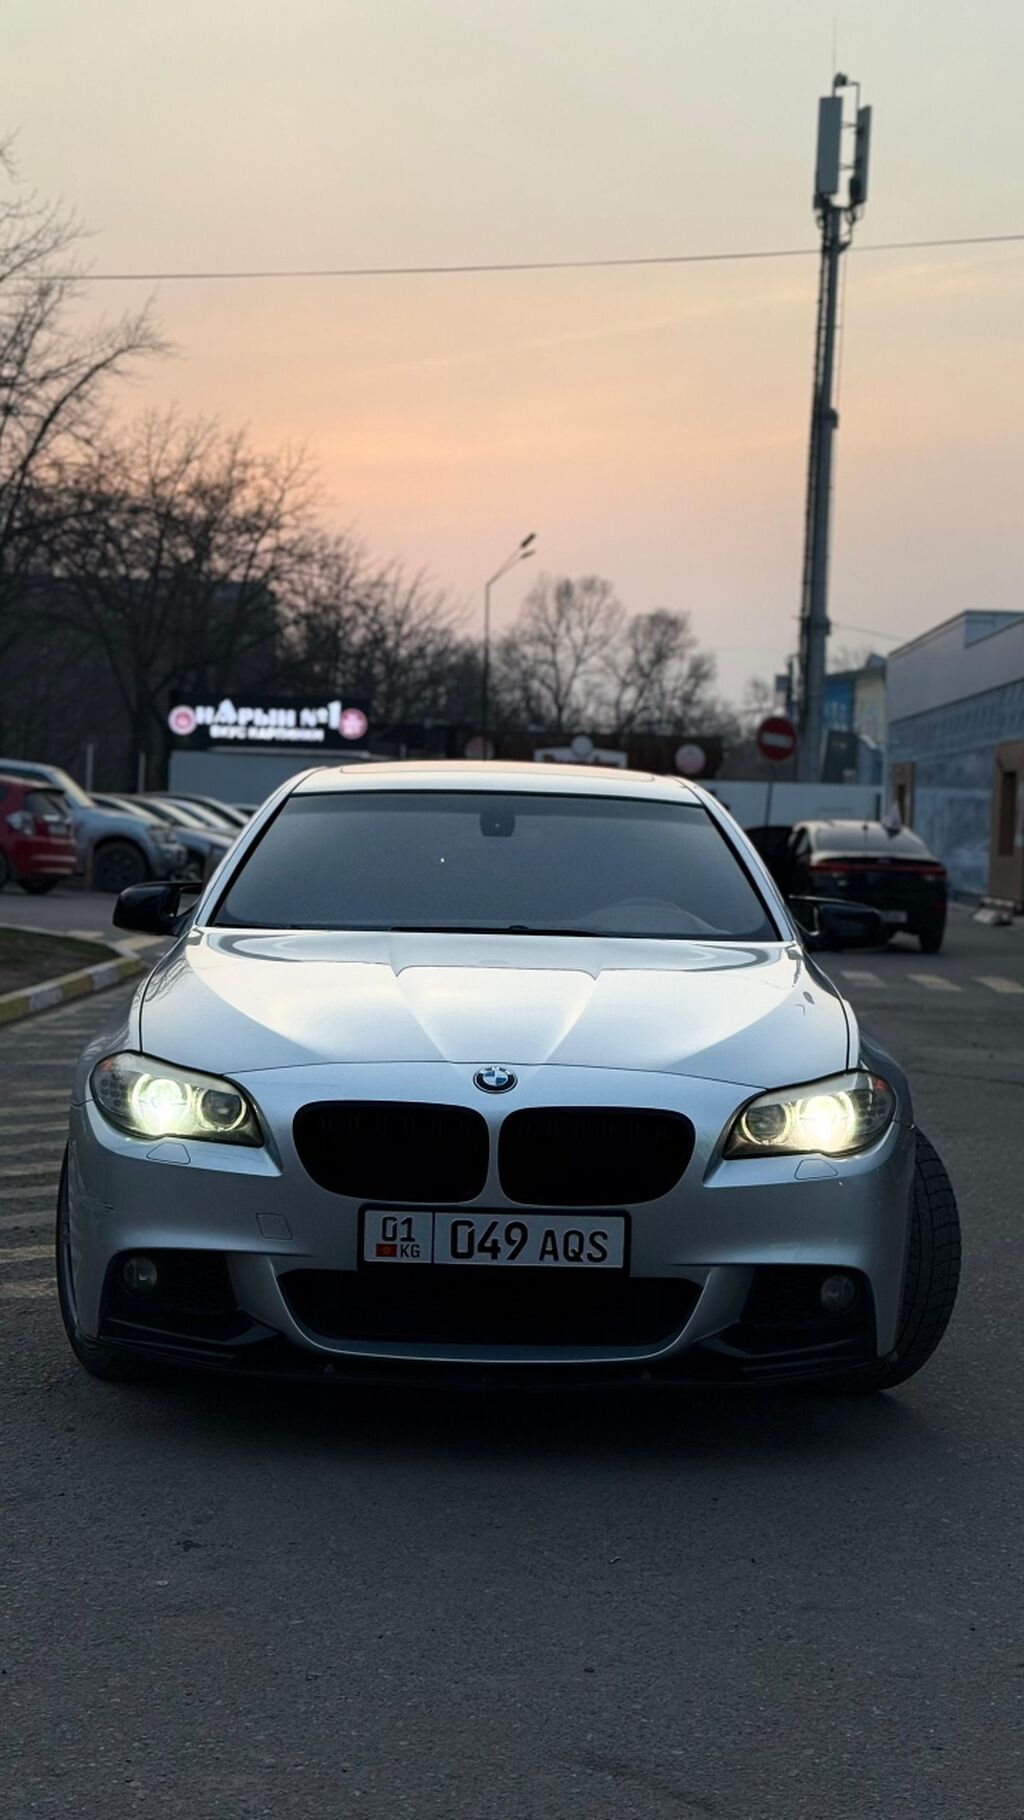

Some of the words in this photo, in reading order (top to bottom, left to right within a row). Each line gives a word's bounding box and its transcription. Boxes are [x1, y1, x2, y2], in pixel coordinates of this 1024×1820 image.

[381, 1216, 416, 1243] 01
[450, 1219, 529, 1261] 049
[539, 1228, 609, 1263] AQS
[399, 1243, 421, 1259] KG
